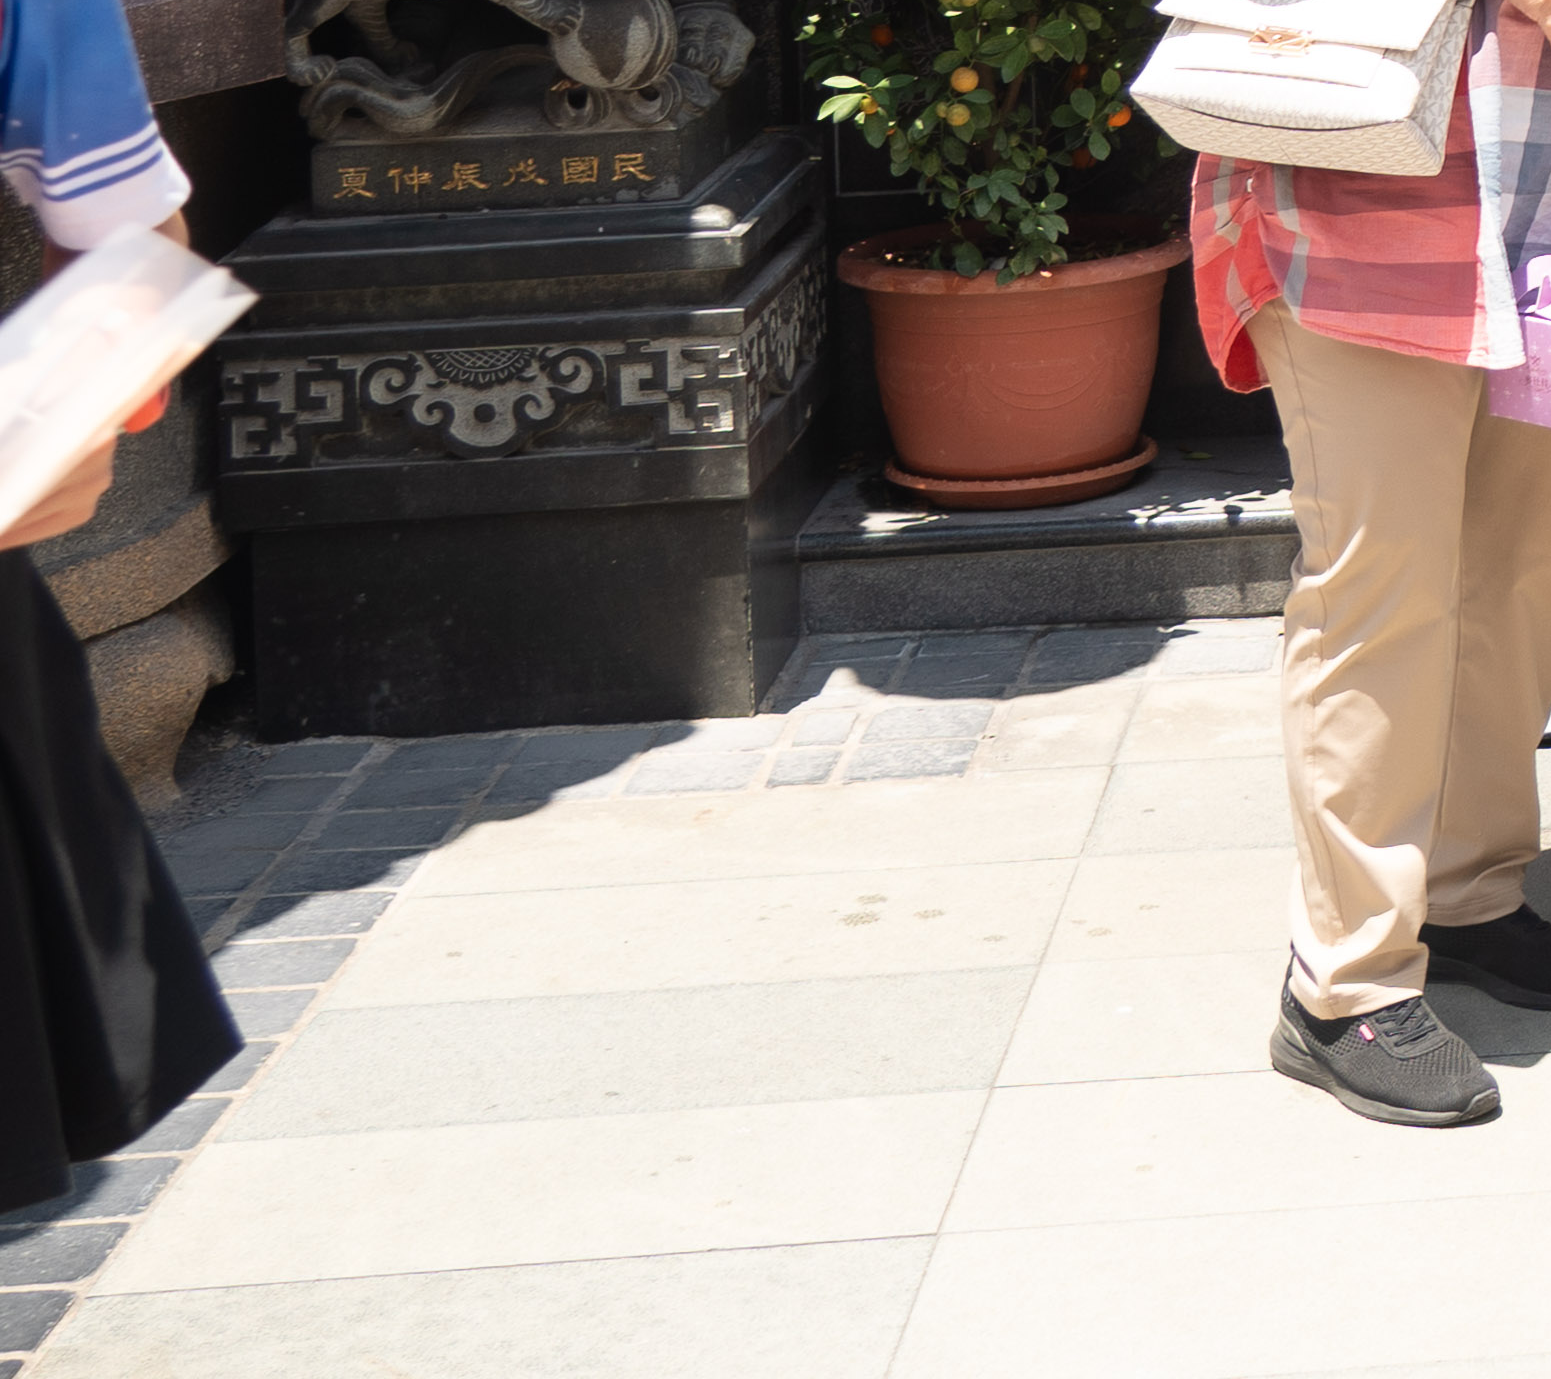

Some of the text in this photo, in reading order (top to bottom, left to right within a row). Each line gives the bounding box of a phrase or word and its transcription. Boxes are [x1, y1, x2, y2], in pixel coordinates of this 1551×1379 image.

[333, 152, 656, 200] 民國戊辰仲夏
